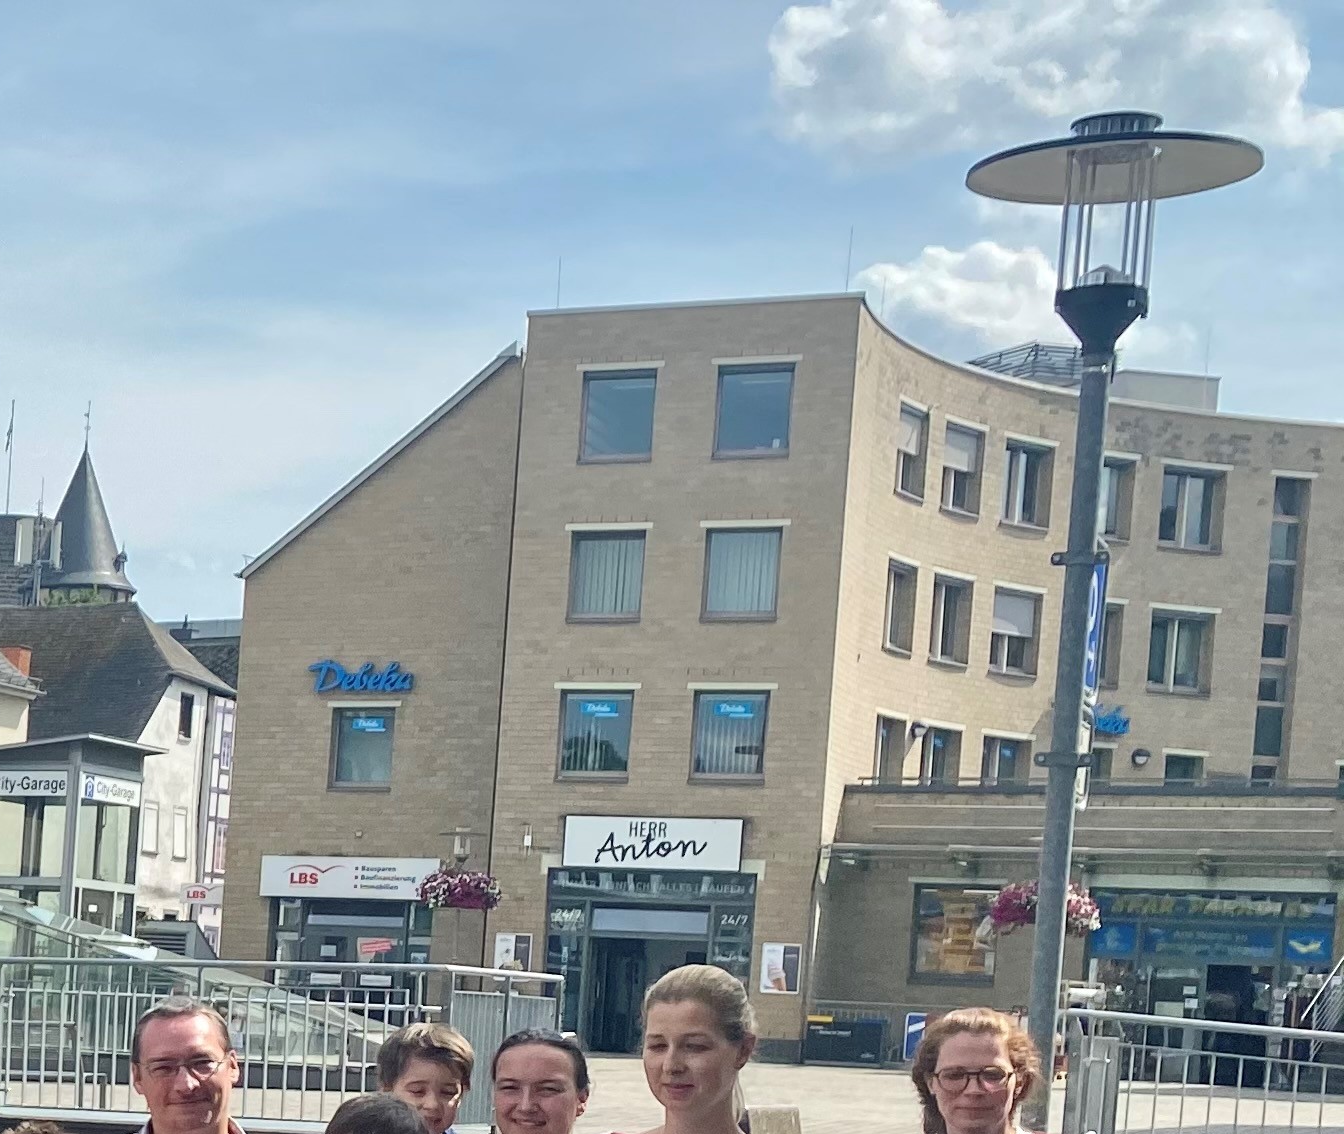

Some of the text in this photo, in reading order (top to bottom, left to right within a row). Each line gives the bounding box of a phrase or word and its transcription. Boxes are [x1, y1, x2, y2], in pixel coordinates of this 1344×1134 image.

[308, 659, 414, 693] Debeka
[96, 781, 135, 802] City-Garage
[629, 821, 668, 839] HERR
[594, 831, 708, 864] Anton
[289, 872, 319, 885] LBS
[186, 890, 207, 899] LBS
[720, 914, 749, 926] 24/7
